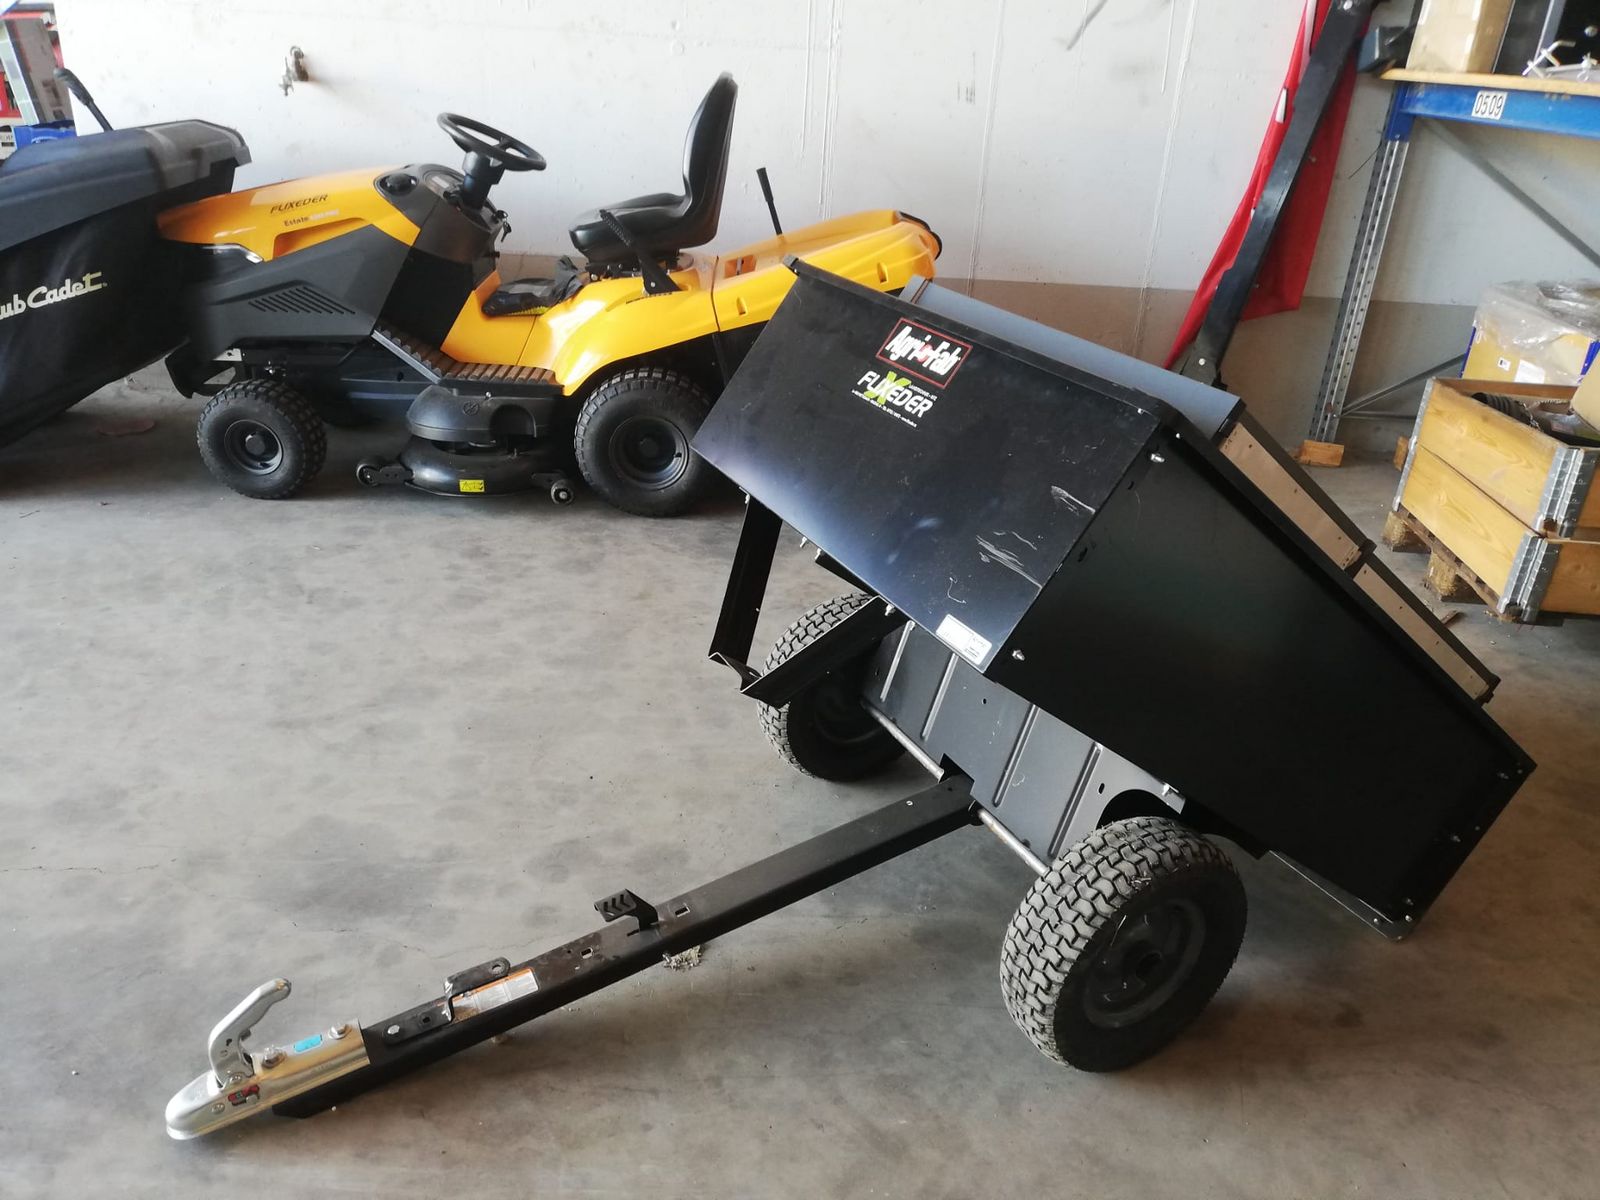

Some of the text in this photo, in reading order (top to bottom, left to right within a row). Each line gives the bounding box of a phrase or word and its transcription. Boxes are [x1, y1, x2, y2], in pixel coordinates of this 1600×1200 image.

[1474, 94, 1504, 117] 0509
[269, 194, 329, 214] FUXEDER
[283, 216, 310, 227] Estate
[0, 271, 103, 321] ub Cadet
[856, 370, 934, 419] FUXEDER
